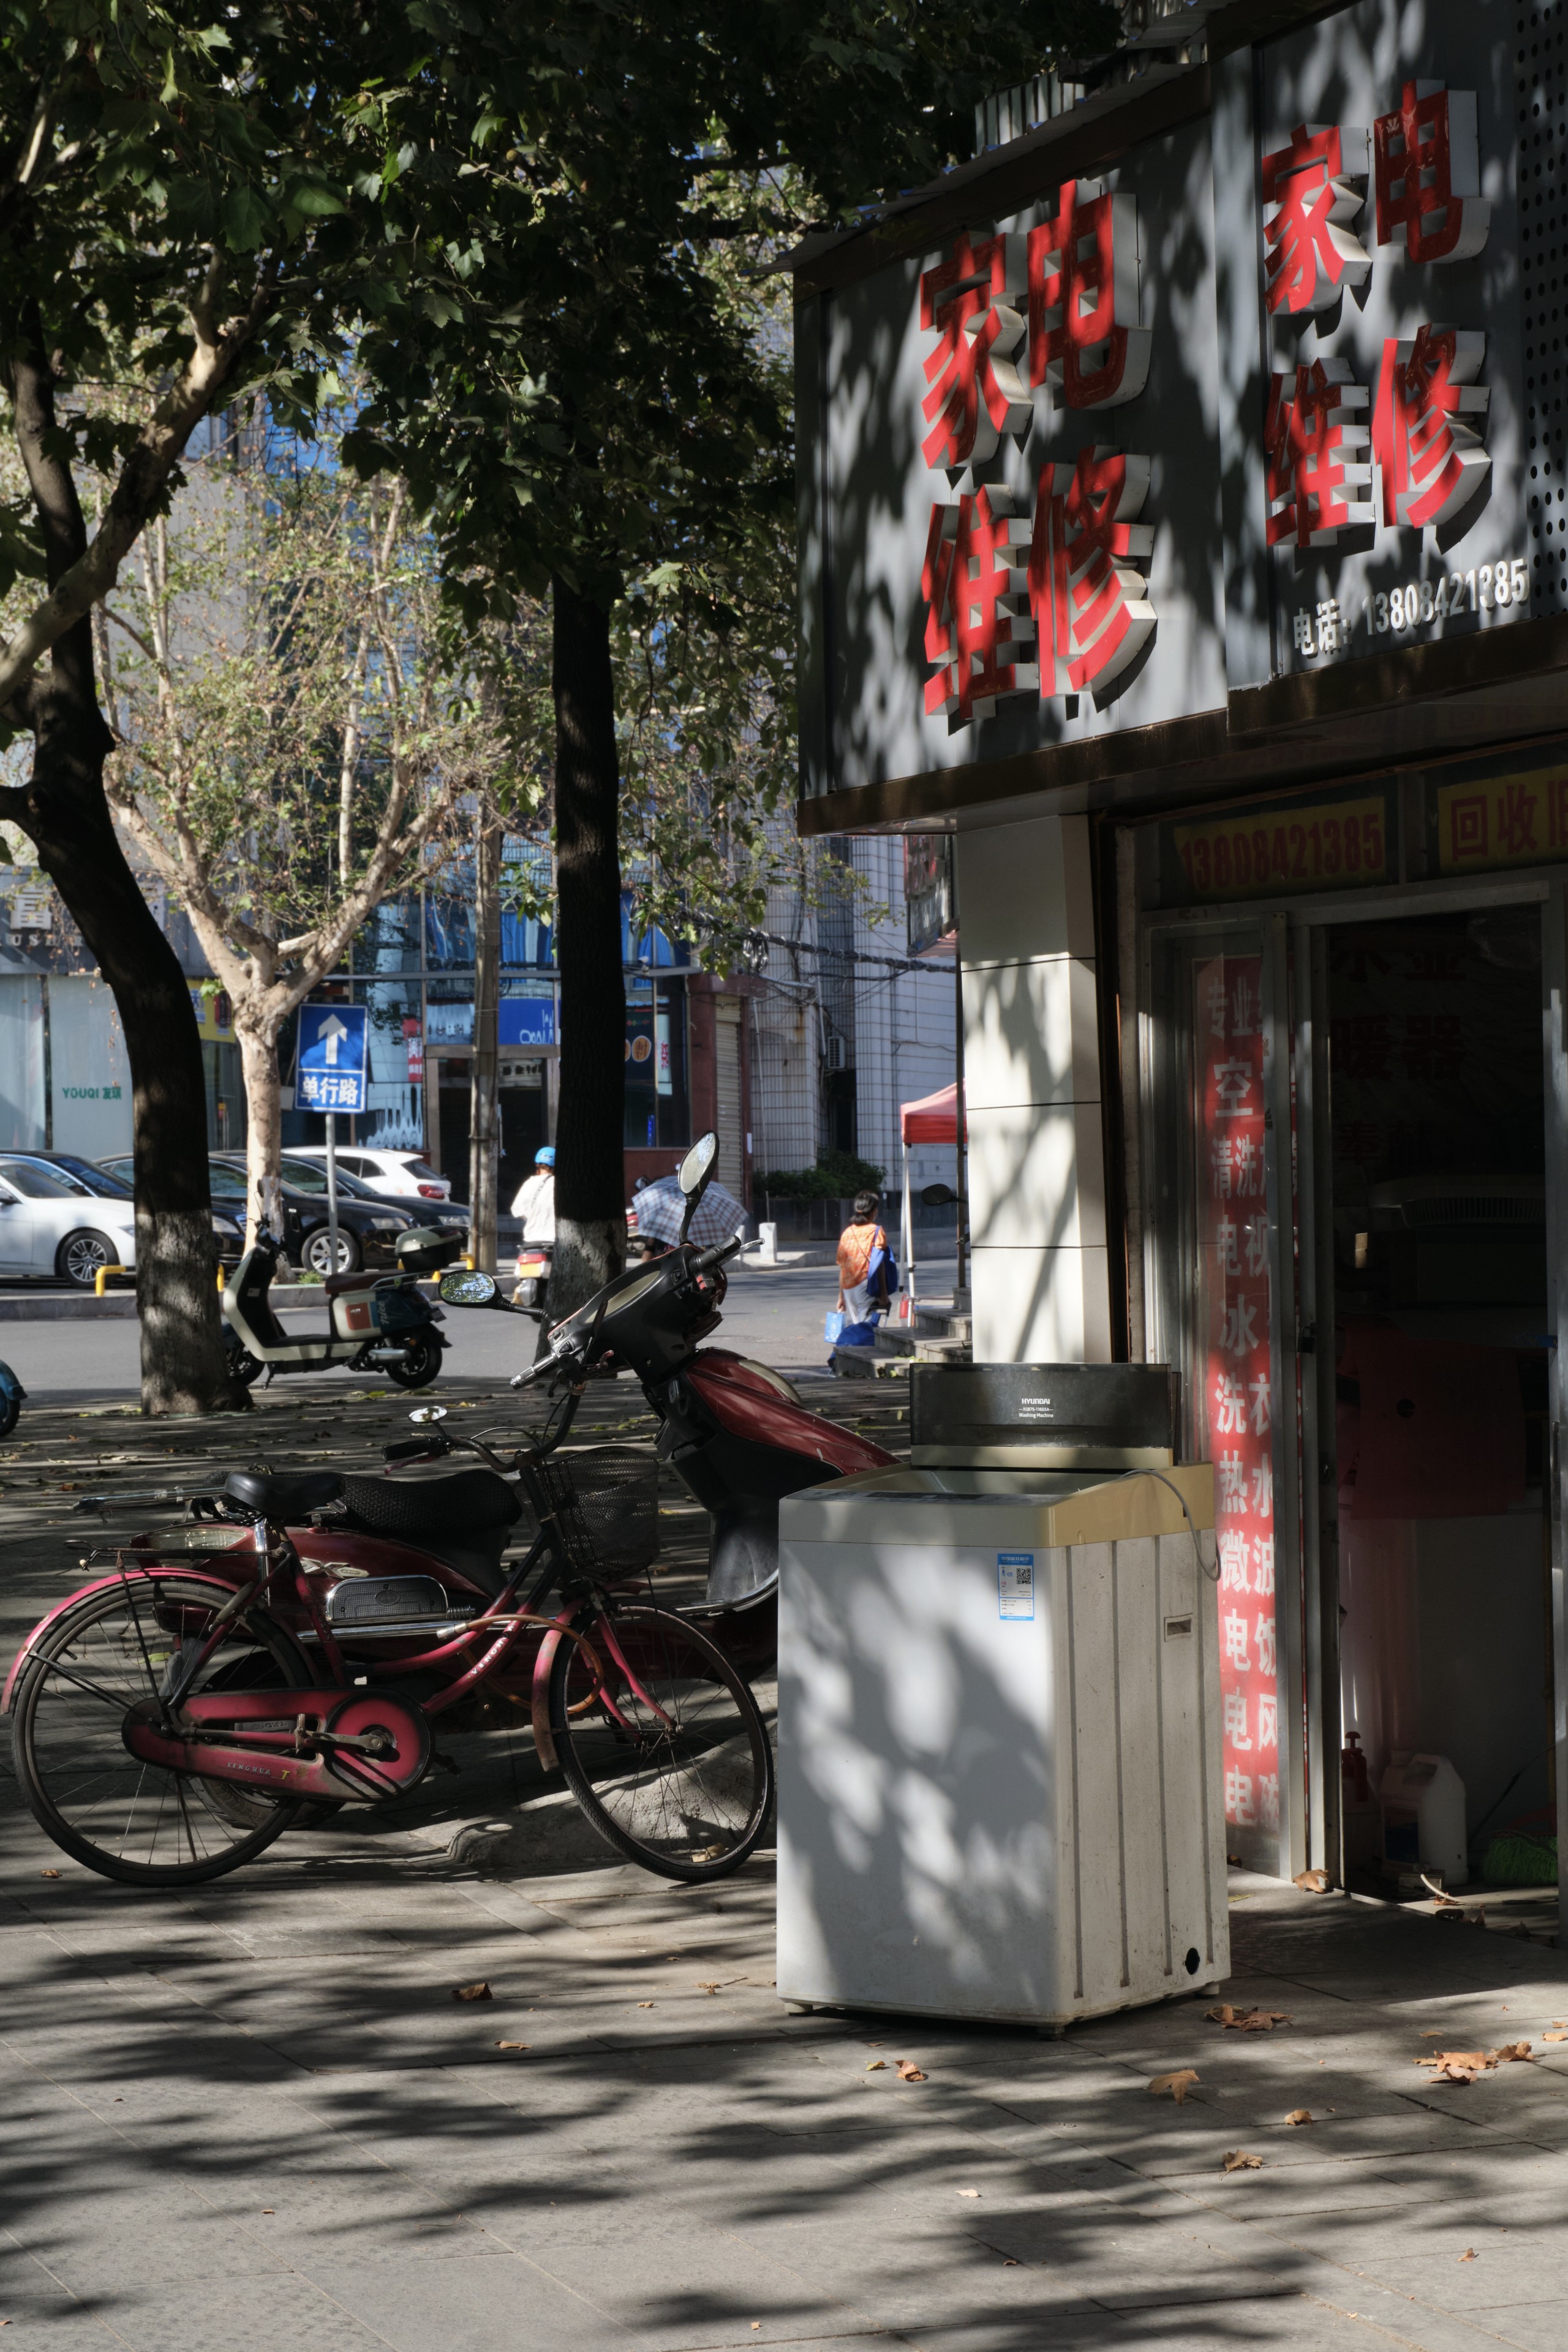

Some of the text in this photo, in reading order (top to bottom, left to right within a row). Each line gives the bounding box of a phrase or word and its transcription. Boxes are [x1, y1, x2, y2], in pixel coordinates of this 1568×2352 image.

[1262, 78, 1485, 315] 家电
[920, 178, 1147, 470] 家电
[1264, 323, 1487, 548] 维修
[921, 445, 1152, 719] 维修
[1362, 559, 1531, 635] 13808421385
[1182, 813, 1383, 891] 13808421385
[1207, 976, 1263, 1039] 专业
[62, 1087, 99, 1099] YOUQI
[301, 1076, 358, 1106] 单行路
[227, 1762, 271, 1775] YINGHUA
